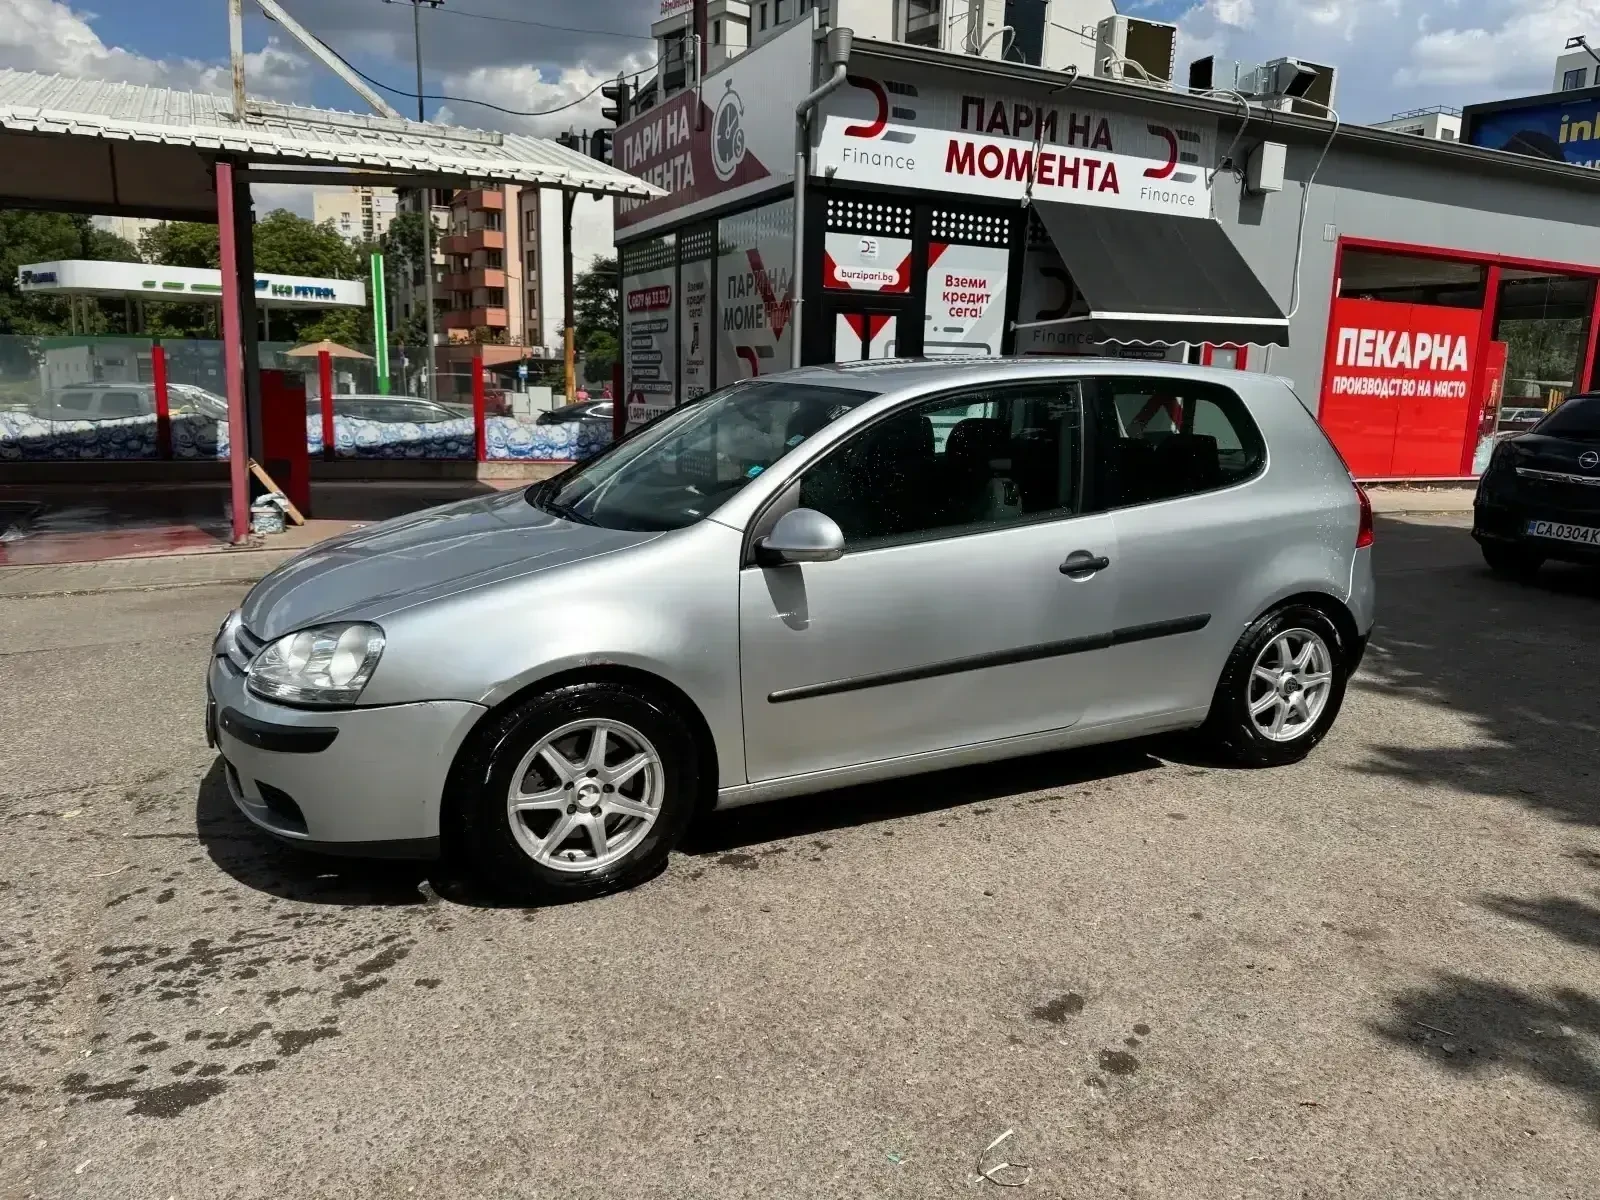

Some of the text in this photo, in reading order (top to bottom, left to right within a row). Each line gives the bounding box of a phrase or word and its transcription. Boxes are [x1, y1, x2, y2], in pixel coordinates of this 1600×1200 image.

[960, 95, 1113, 152] ПАРИ НА
[623, 105, 690, 172] ПАРИ НА
[842, 148, 916, 171] Finance
[945, 139, 1120, 195] МОМЕНТА
[1140, 186, 1196, 206] Finance
[728, 270, 763, 299] ПАРИ
[841, 269, 894, 283] burzipari.bg
[945, 274, 987, 289] Вземи
[942, 291, 991, 305] кредит
[948, 306, 982, 319] сега!
[1033, 329, 1095, 345] Finance
[1335, 327, 1468, 372] ПЕКАРНА
[1332, 376, 1466, 398] ПРОИЗВОДСТВО НА МЯСТО
